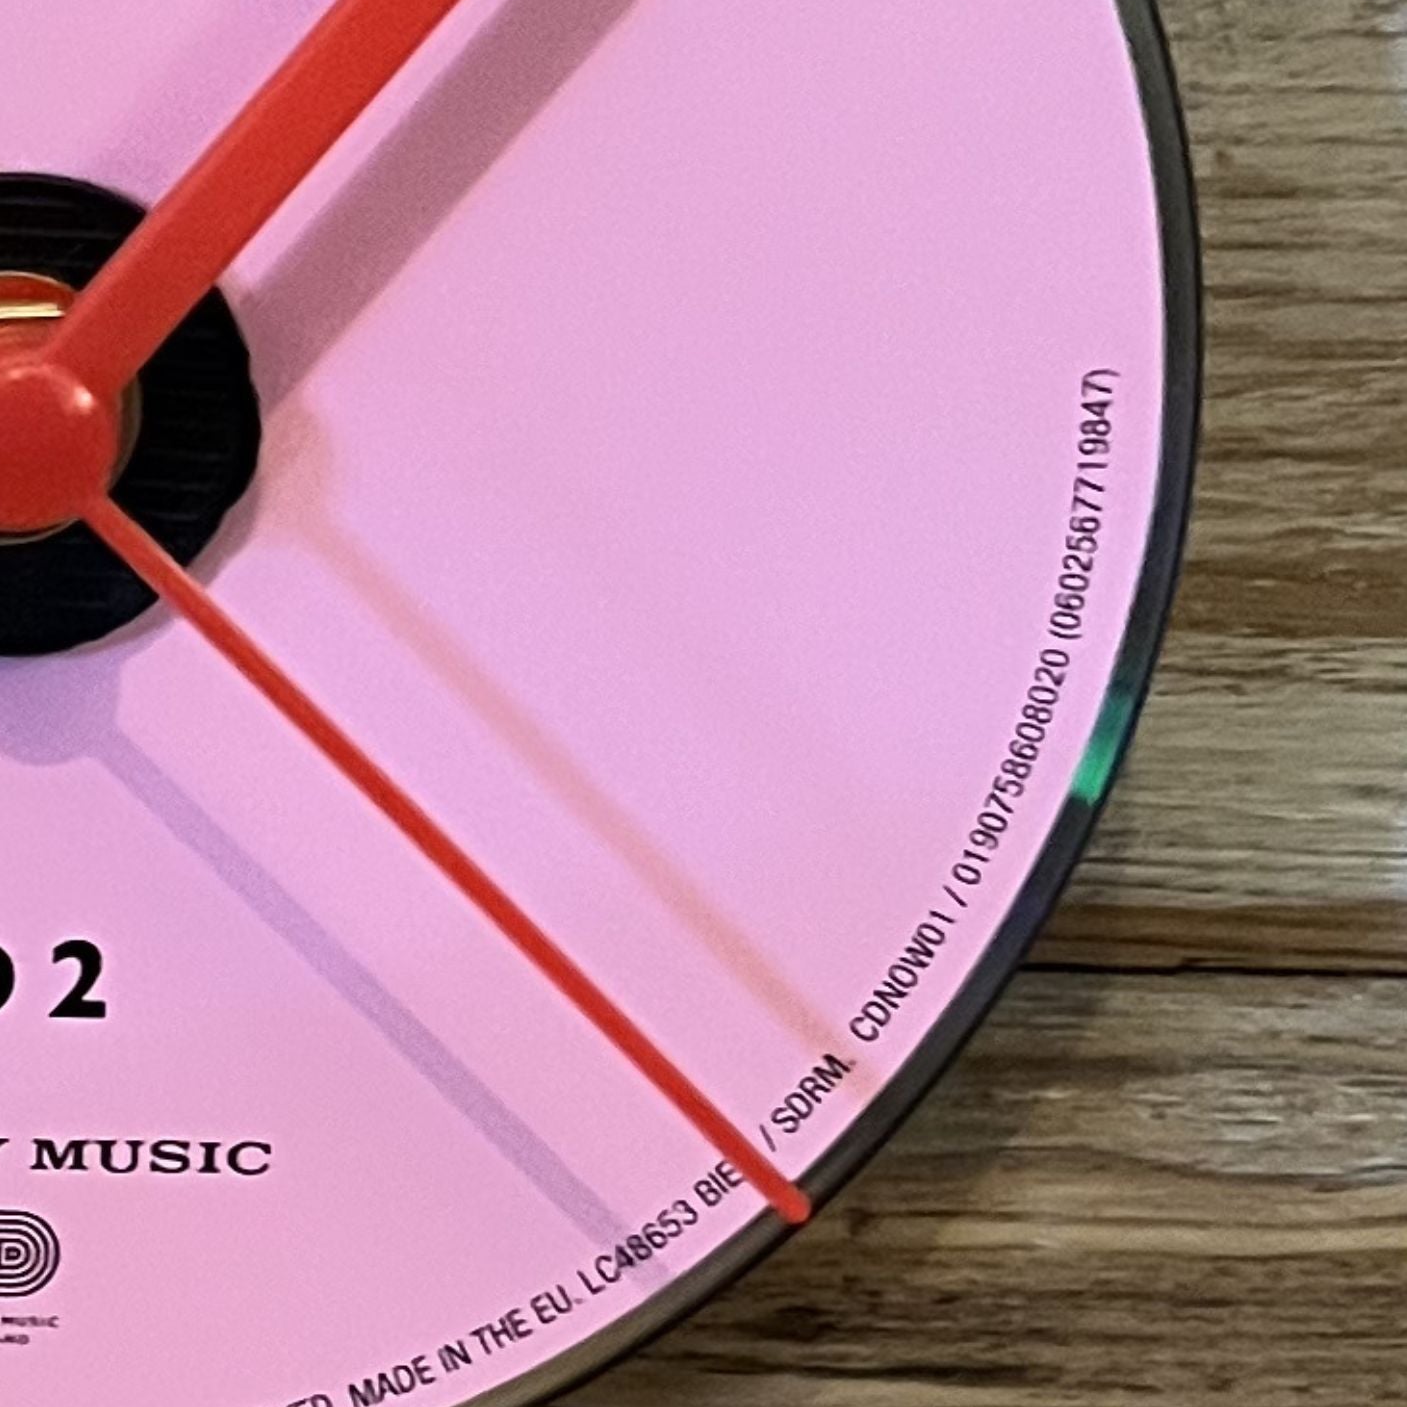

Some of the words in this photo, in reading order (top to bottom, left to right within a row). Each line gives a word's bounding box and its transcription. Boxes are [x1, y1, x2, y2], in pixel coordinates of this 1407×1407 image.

[437, 1339, 473, 1374] IN
[468, 1307, 534, 1356] THE
[529, 1284, 583, 1325] EU.
[576, 1199, 699, 1296] LC48653
[693, 1160, 746, 1207] BIE
[770, 1053, 857, 1134] SDRM.
[848, 910, 957, 1043] CDNOW01
[951, 648, 1071, 886] 0190758608020
[1048, 367, 1121, 641] (0602567719847)
[48, 939, 107, 1019] 2
[29, 1138, 273, 1176] MUSIC
